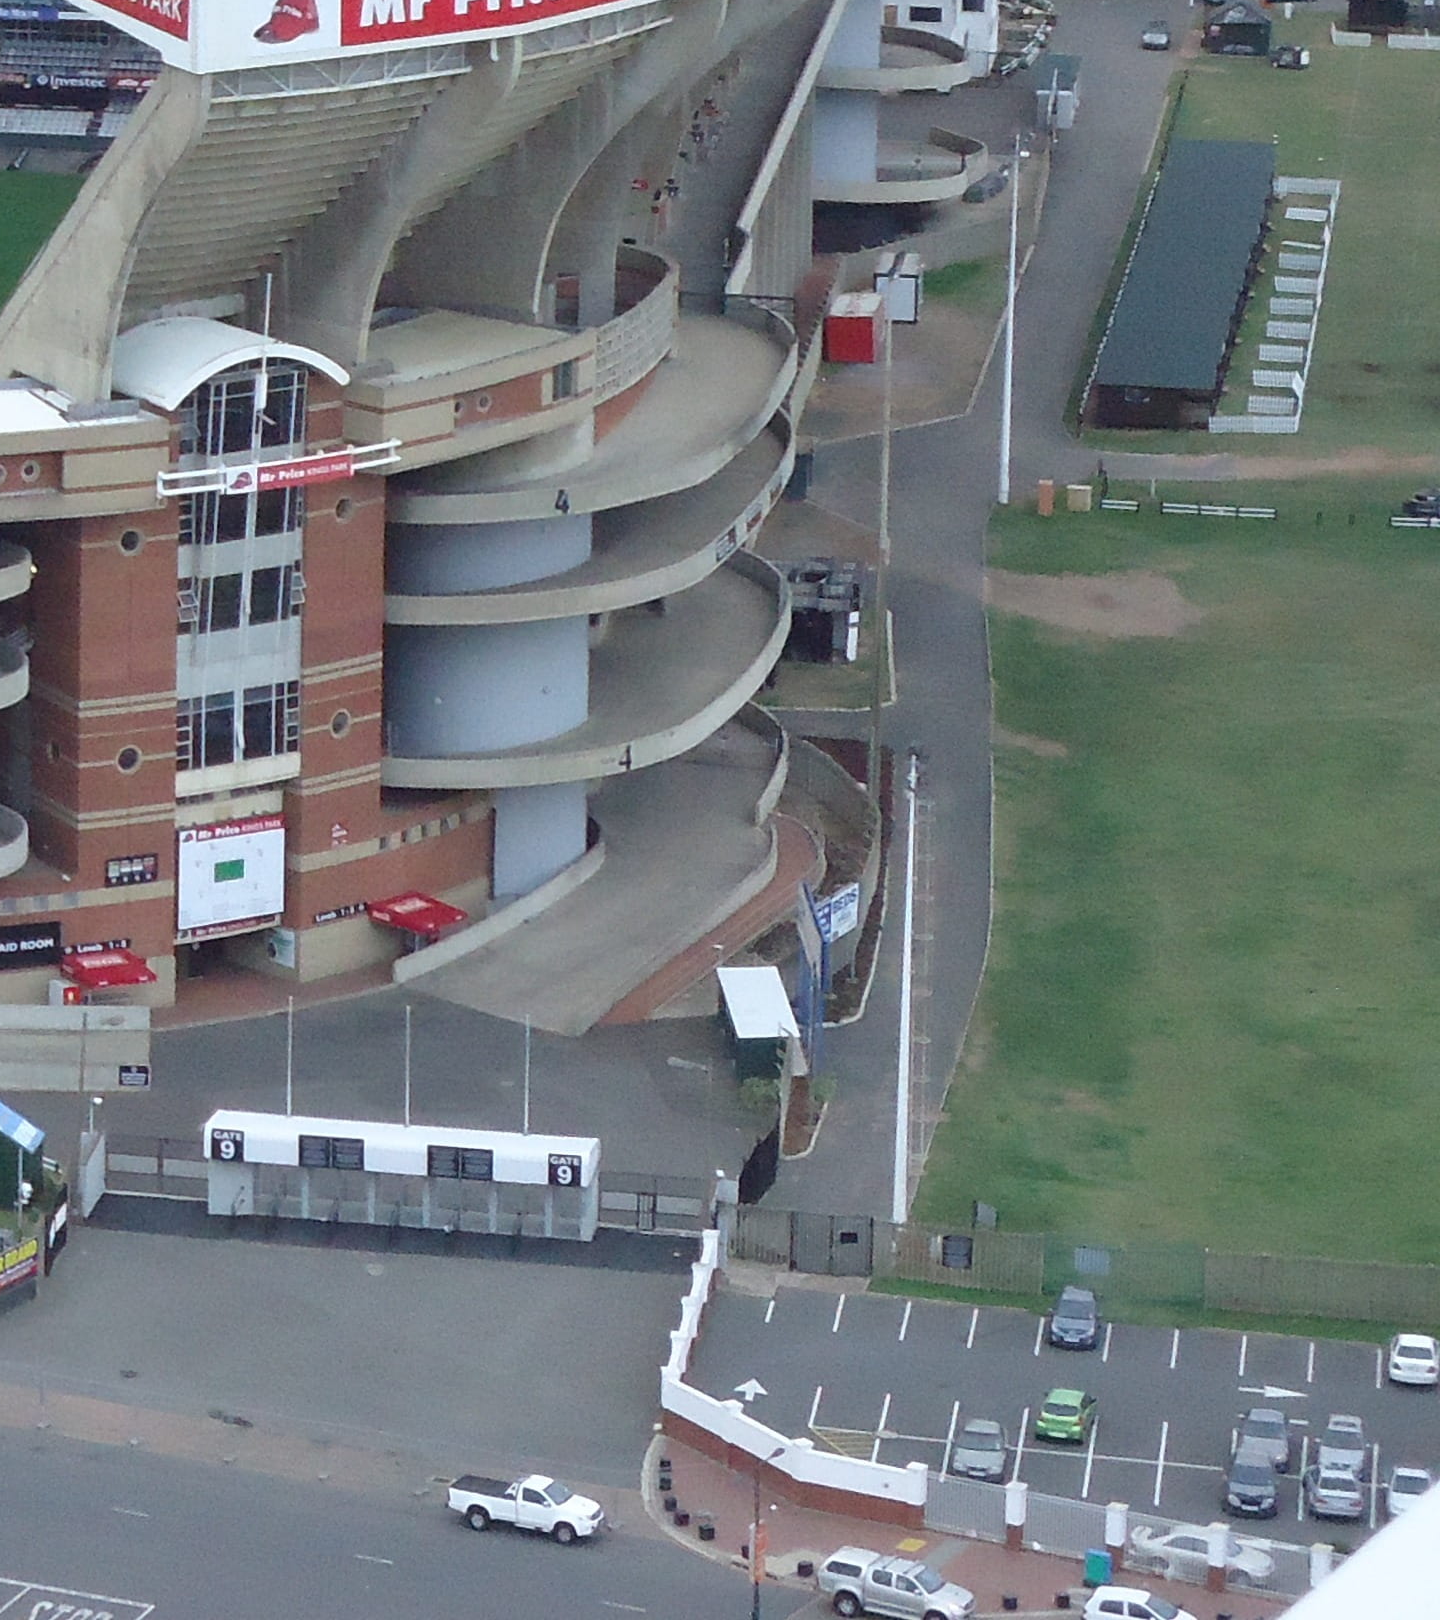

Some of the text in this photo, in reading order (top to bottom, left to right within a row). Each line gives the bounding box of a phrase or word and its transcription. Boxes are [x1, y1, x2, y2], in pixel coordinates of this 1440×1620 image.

[50, 75, 107, 88] Investec
[260, 472, 275, 484] Mr
[279, 468, 305, 482] Price
[215, 826, 241, 838] Price
[20, 938, 54, 951] ROOM
[213, 1130, 242, 1141] GATE
[220, 1140, 236, 1160] 9
[550, 1155, 580, 1166] GATE
[557, 1165, 573, 1185] 9
